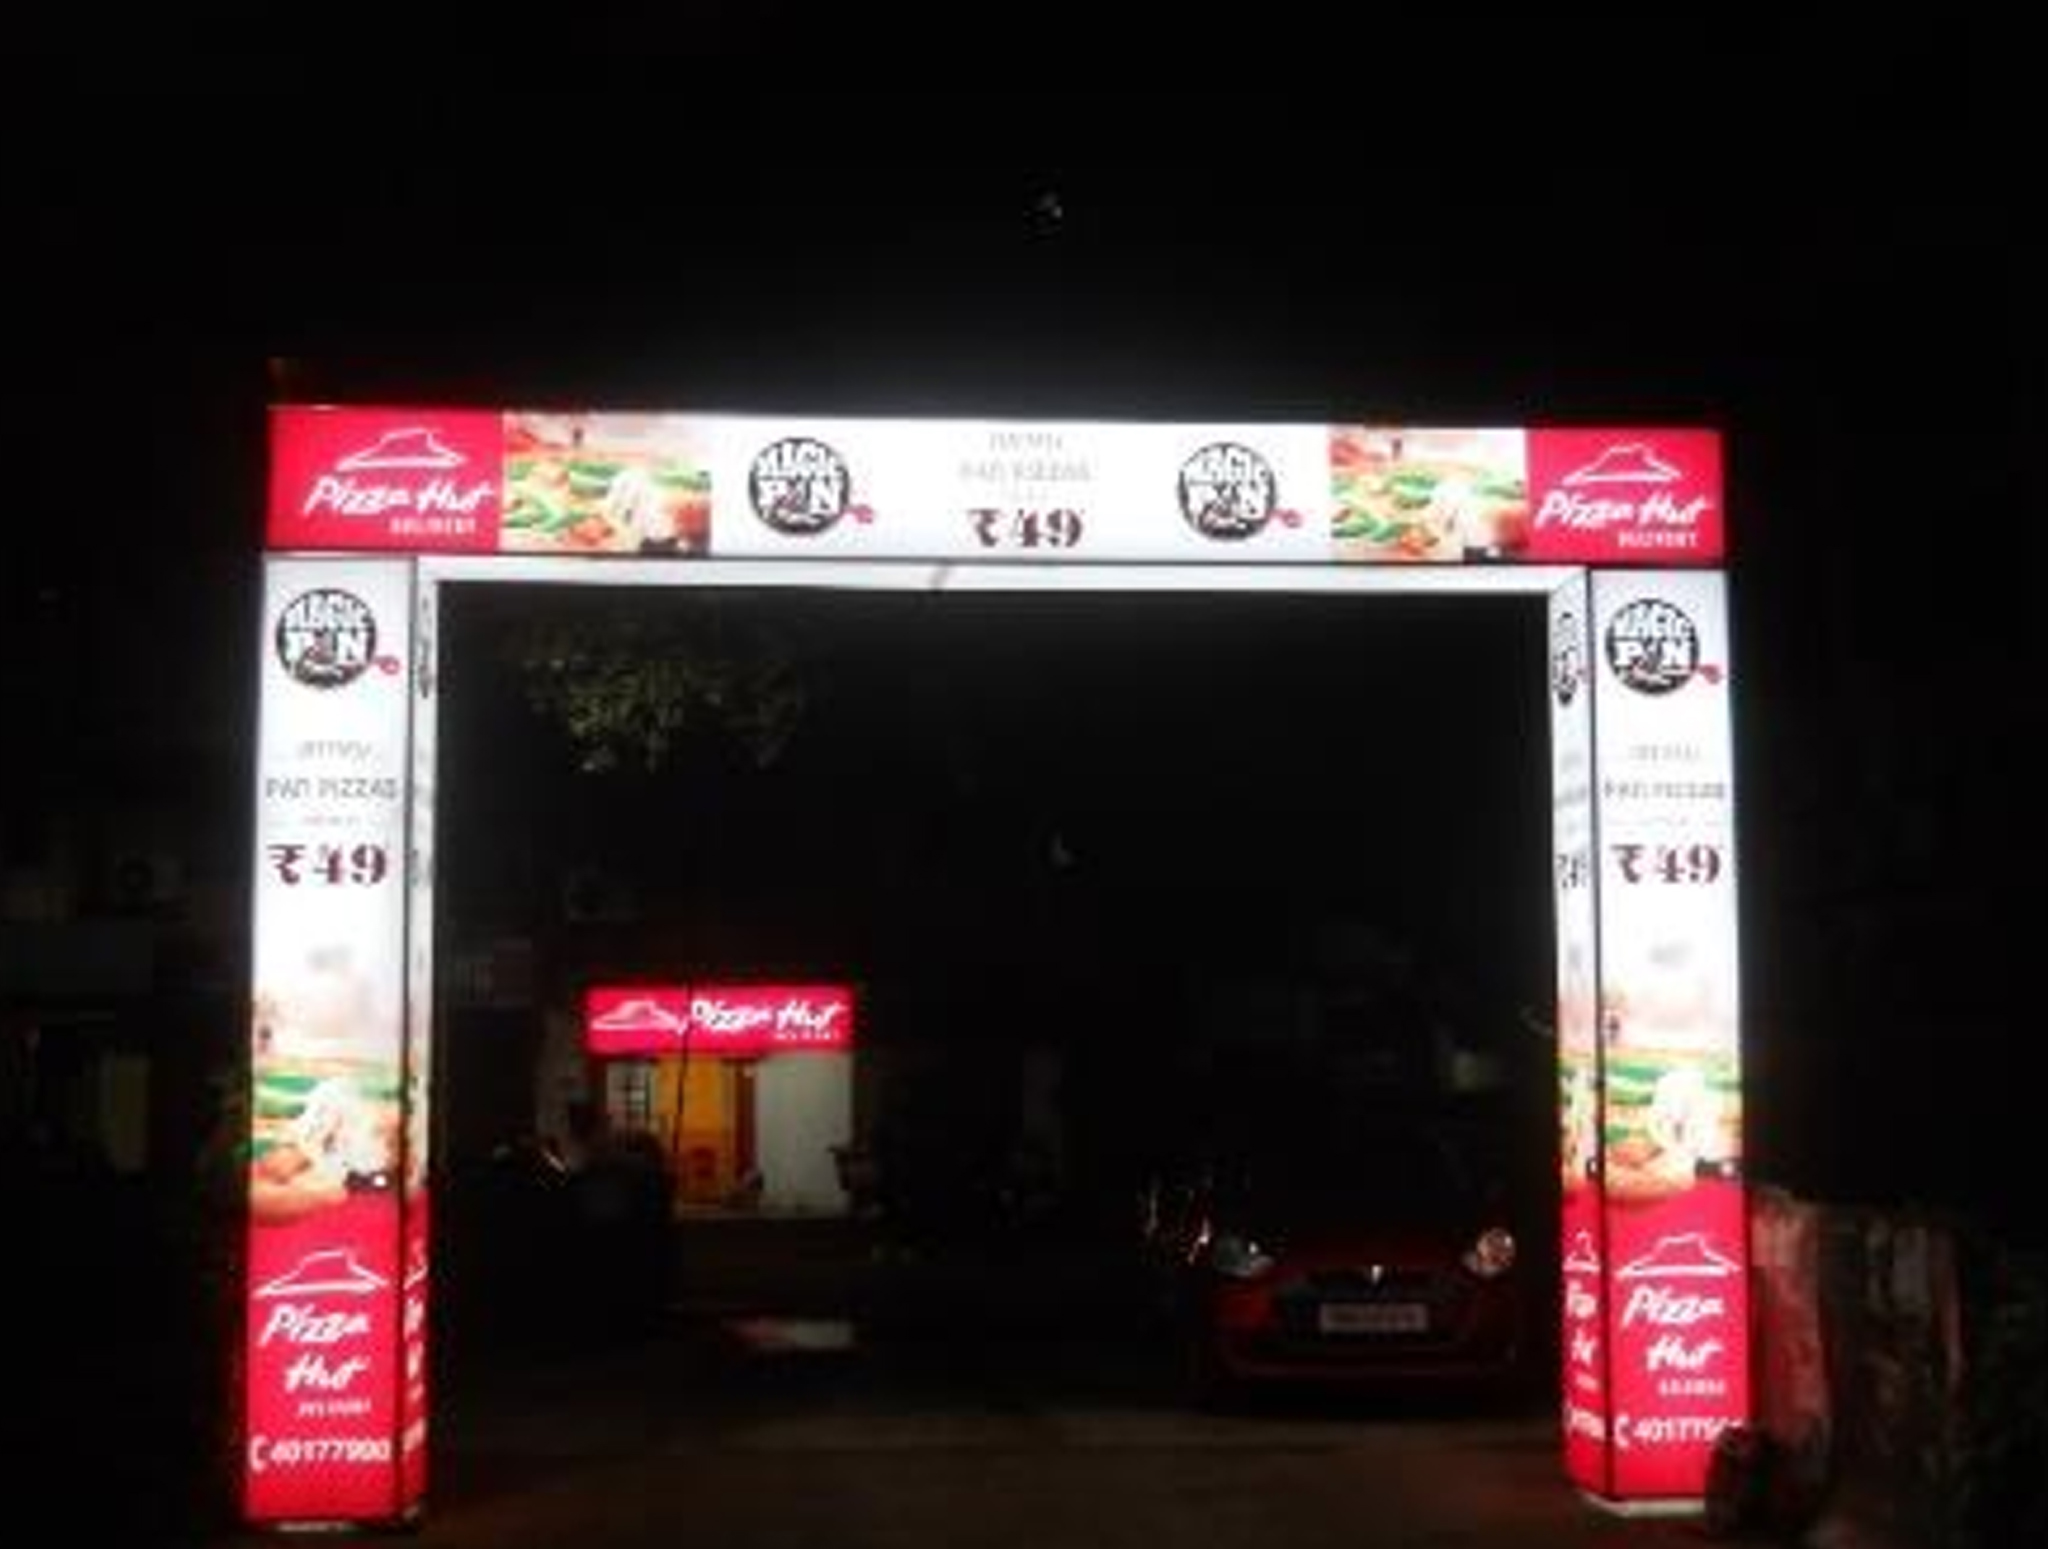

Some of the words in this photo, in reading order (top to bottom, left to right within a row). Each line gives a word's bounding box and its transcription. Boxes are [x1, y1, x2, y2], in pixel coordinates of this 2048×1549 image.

[303, 475, 410, 517] Pizza
[416, 478, 494, 514] Hut
[1534, 491, 1633, 528] Pizza
[1636, 494, 1707, 526] Hut
[690, 998, 772, 1035] Pizza
[775, 999, 848, 1031] Hut
[258, 1302, 370, 1348] Pizza
[1621, 1285, 1725, 1330] Pizza
[1646, 1335, 1725, 1371] Hut
[283, 1354, 370, 1393] Hut
